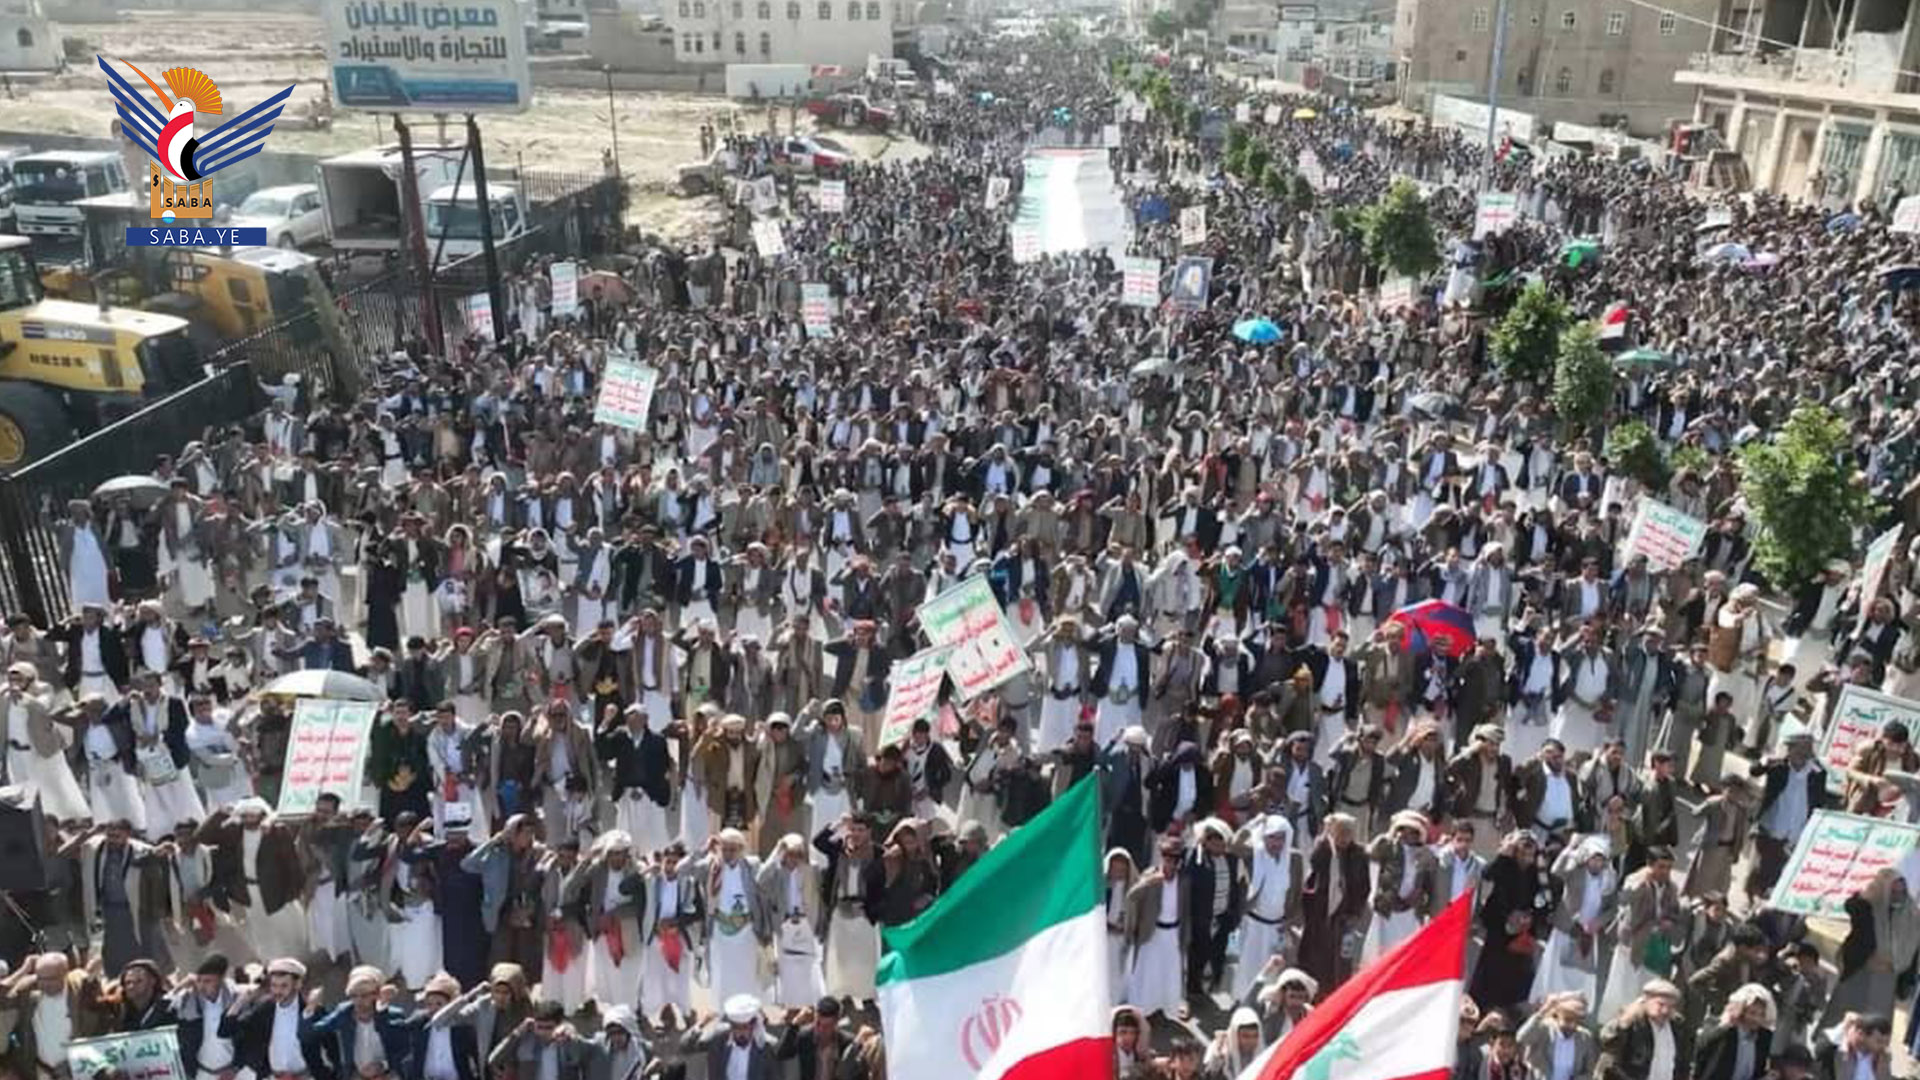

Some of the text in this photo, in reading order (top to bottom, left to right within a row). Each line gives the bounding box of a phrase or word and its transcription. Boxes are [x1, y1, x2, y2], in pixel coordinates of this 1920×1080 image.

[345, 1, 498, 31] معرض اليابان
[339, 35, 507, 62] للتجارة والاستيراد
